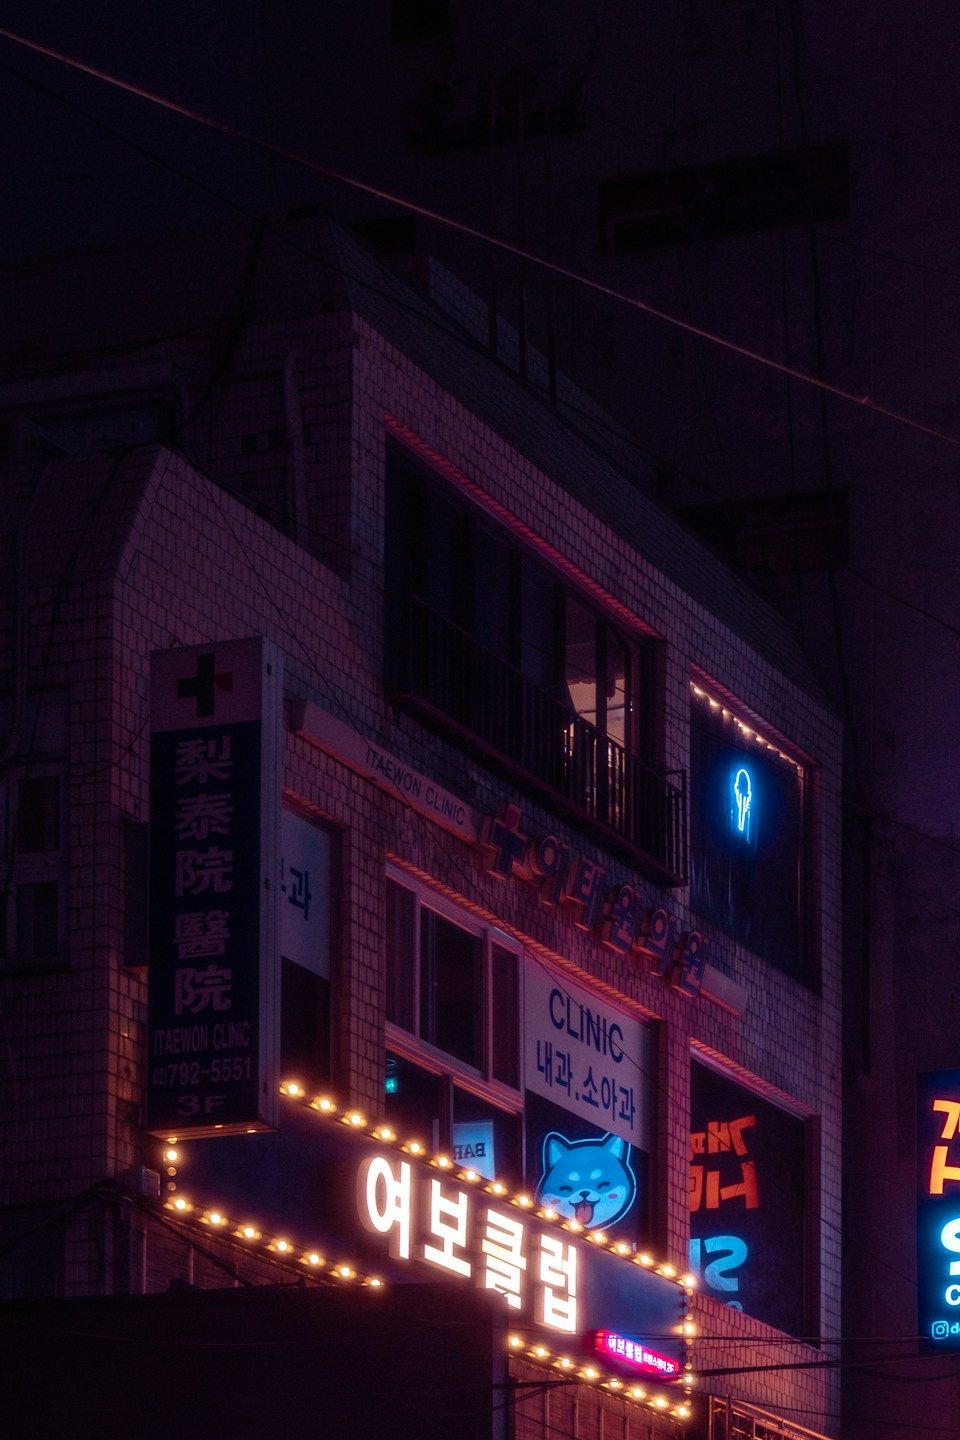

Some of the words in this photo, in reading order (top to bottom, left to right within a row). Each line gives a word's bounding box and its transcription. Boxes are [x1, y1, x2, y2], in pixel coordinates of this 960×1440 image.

[364, 746, 423, 795] ITAEWON
[425, 785, 466, 828] CLINIC
[173, 737, 234, 1015] 梨泰院醫院
[534, 834, 710, 999] 이태원의원
[153, 1025, 208, 1057] ITAEWON
[213, 1021, 250, 1051] CLINIC
[550, 988, 624, 1063] CLINIC
[177, 1094, 226, 1116] 3F
[364, 1156, 577, 1334] 여보클럽
